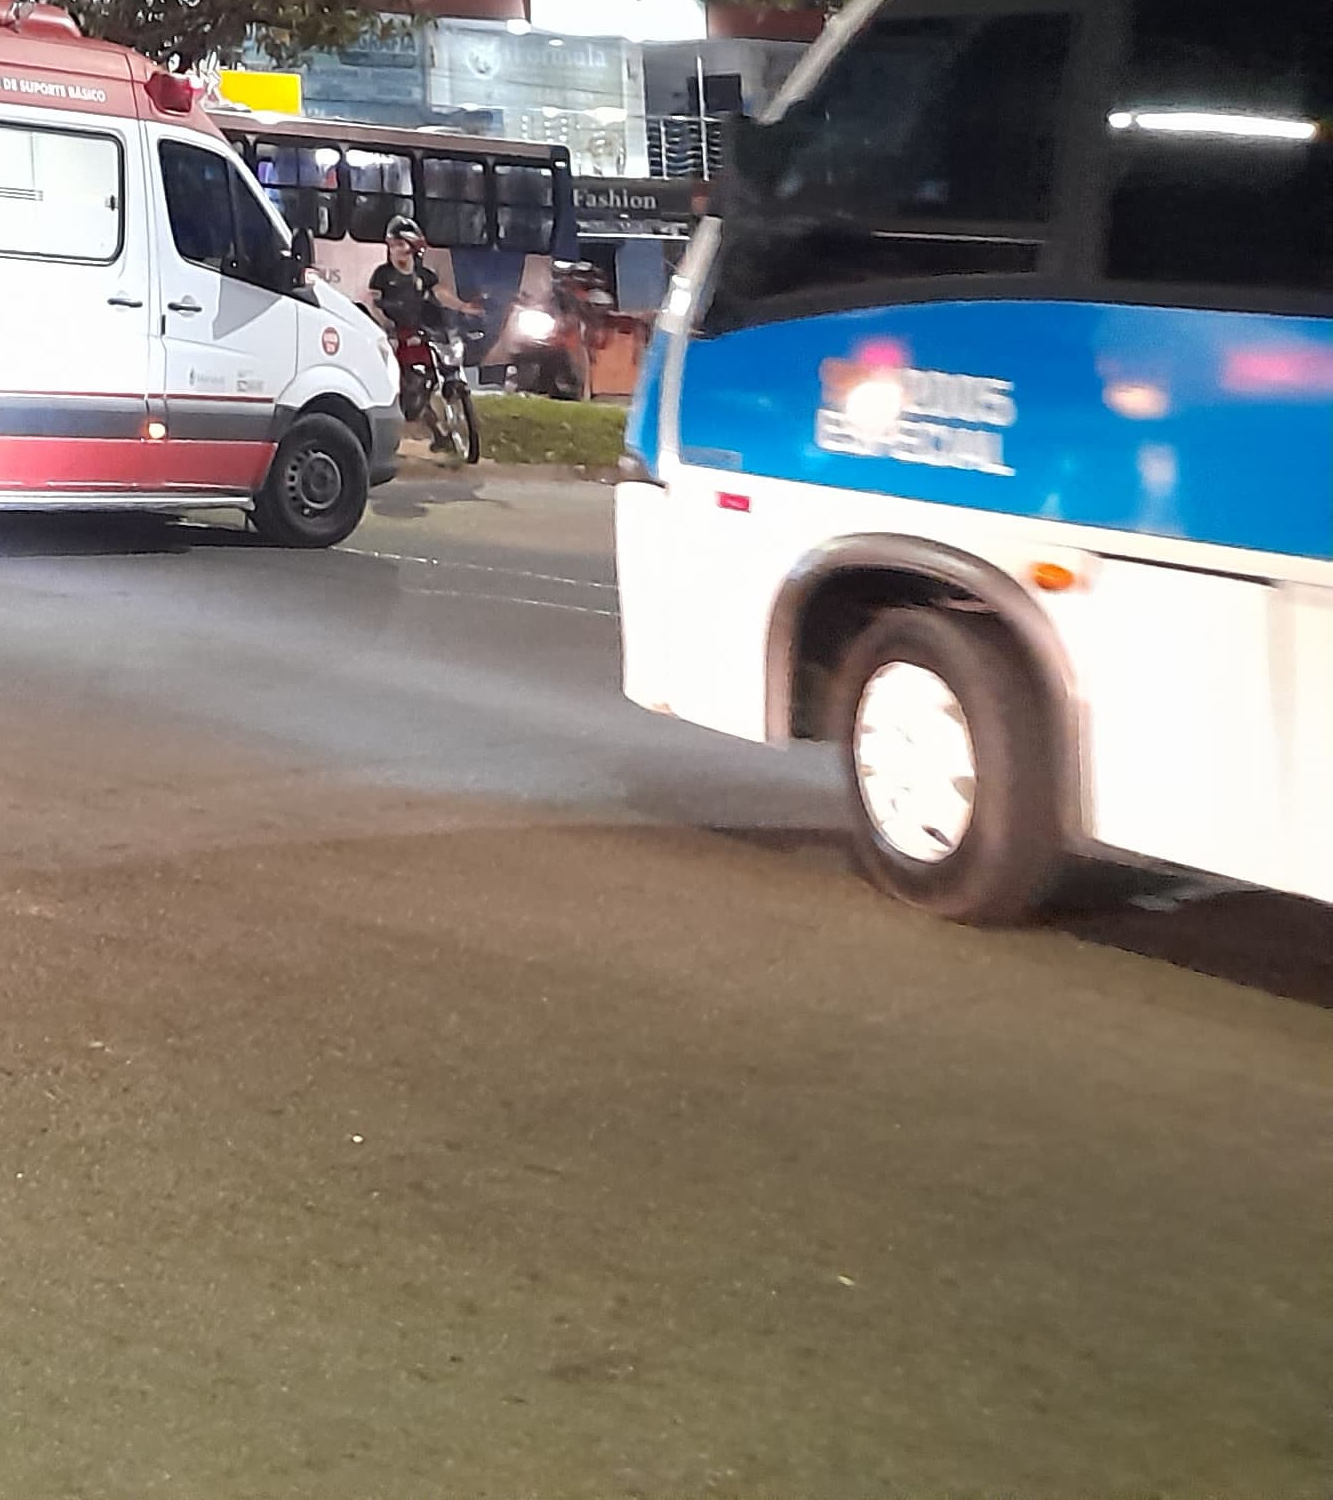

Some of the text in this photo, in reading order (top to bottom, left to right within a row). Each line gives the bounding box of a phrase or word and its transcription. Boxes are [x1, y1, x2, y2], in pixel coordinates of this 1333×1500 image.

[3, 76, 18, 91] DE
[19, 78, 67, 98] SUPORTE
[572, 188, 657, 210] Fashion
